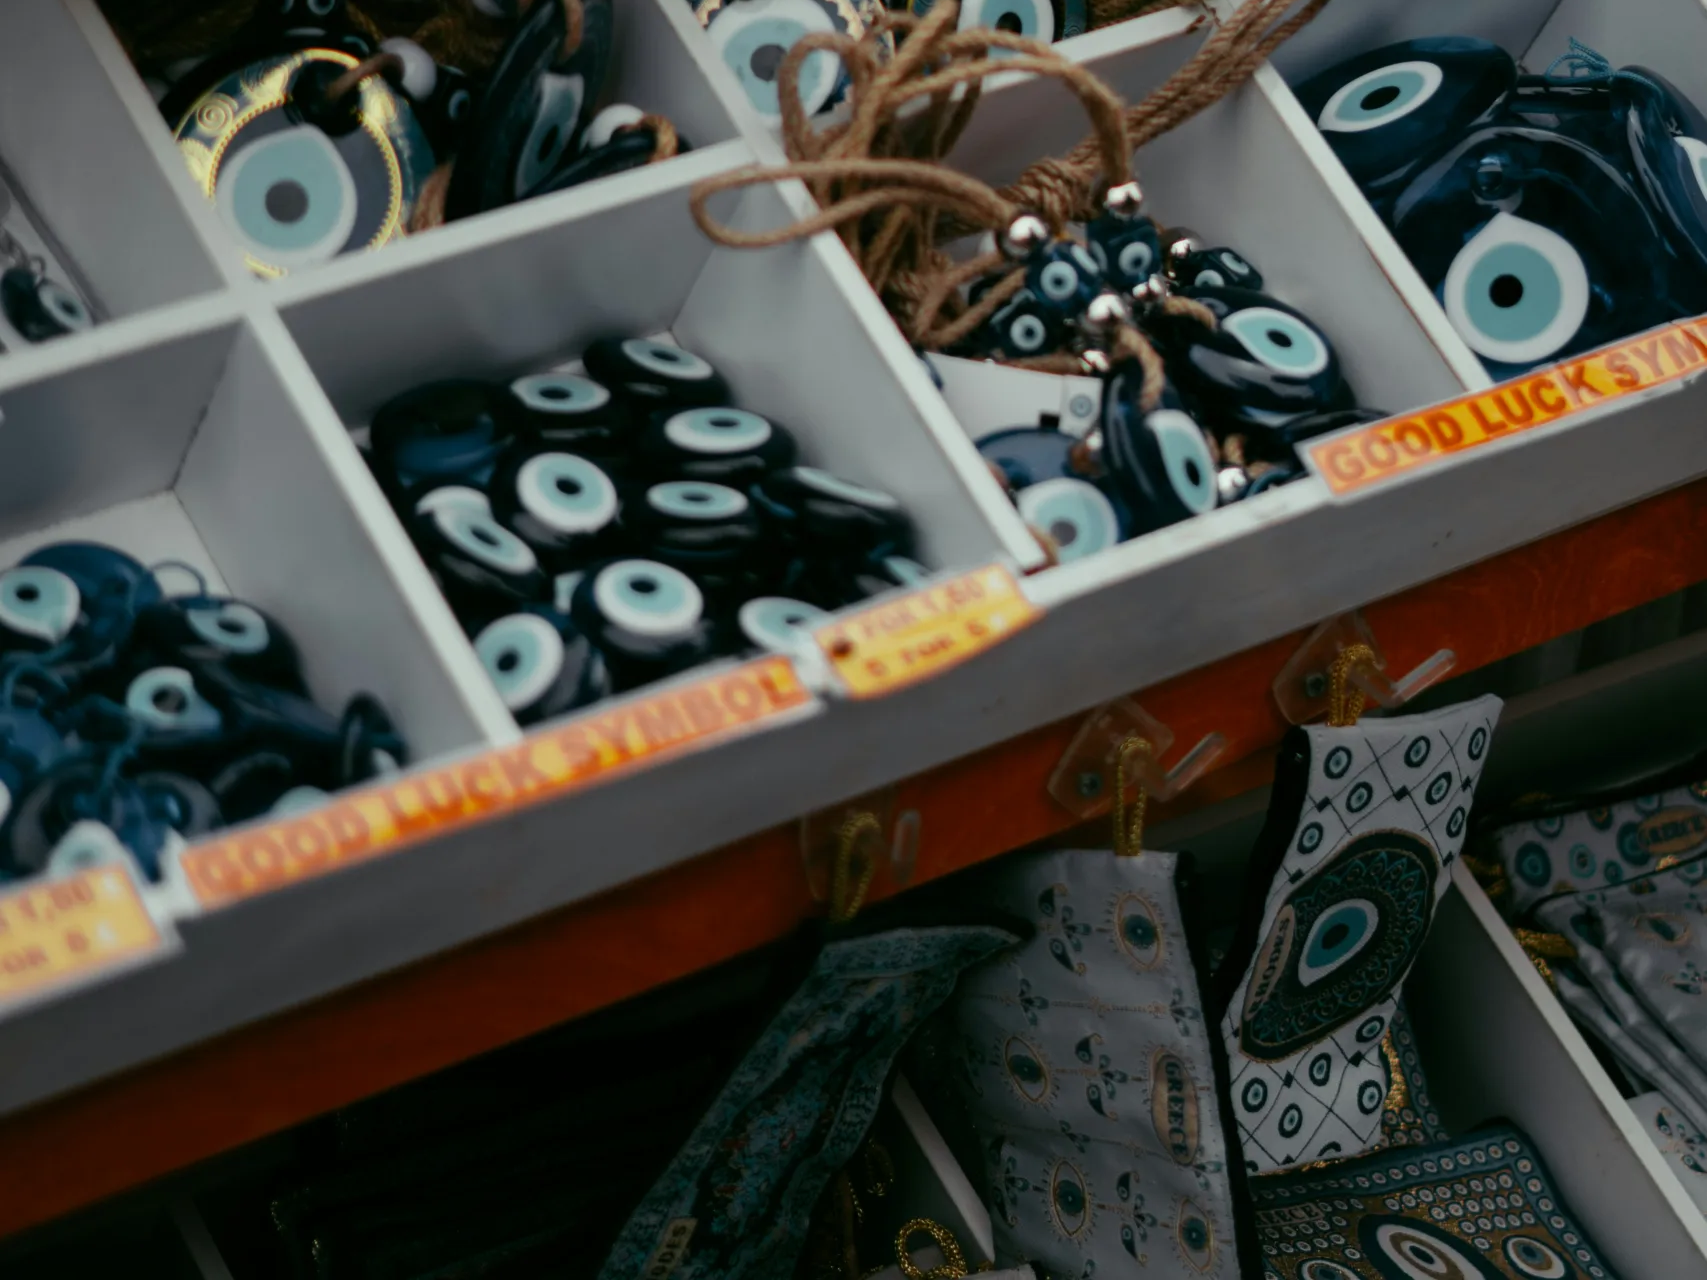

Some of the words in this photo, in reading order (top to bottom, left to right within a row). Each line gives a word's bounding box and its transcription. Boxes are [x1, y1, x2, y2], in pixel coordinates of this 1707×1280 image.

[1325, 409, 1464, 483] GOOD
[1466, 364, 1604, 437] LUCK
[195, 806, 373, 892] GOOD
[379, 744, 542, 836] LUCK
[554, 660, 811, 778] SYMBOL
[1248, 918, 1291, 1015] RHODES
[1164, 1061, 1189, 1156] GREECE
